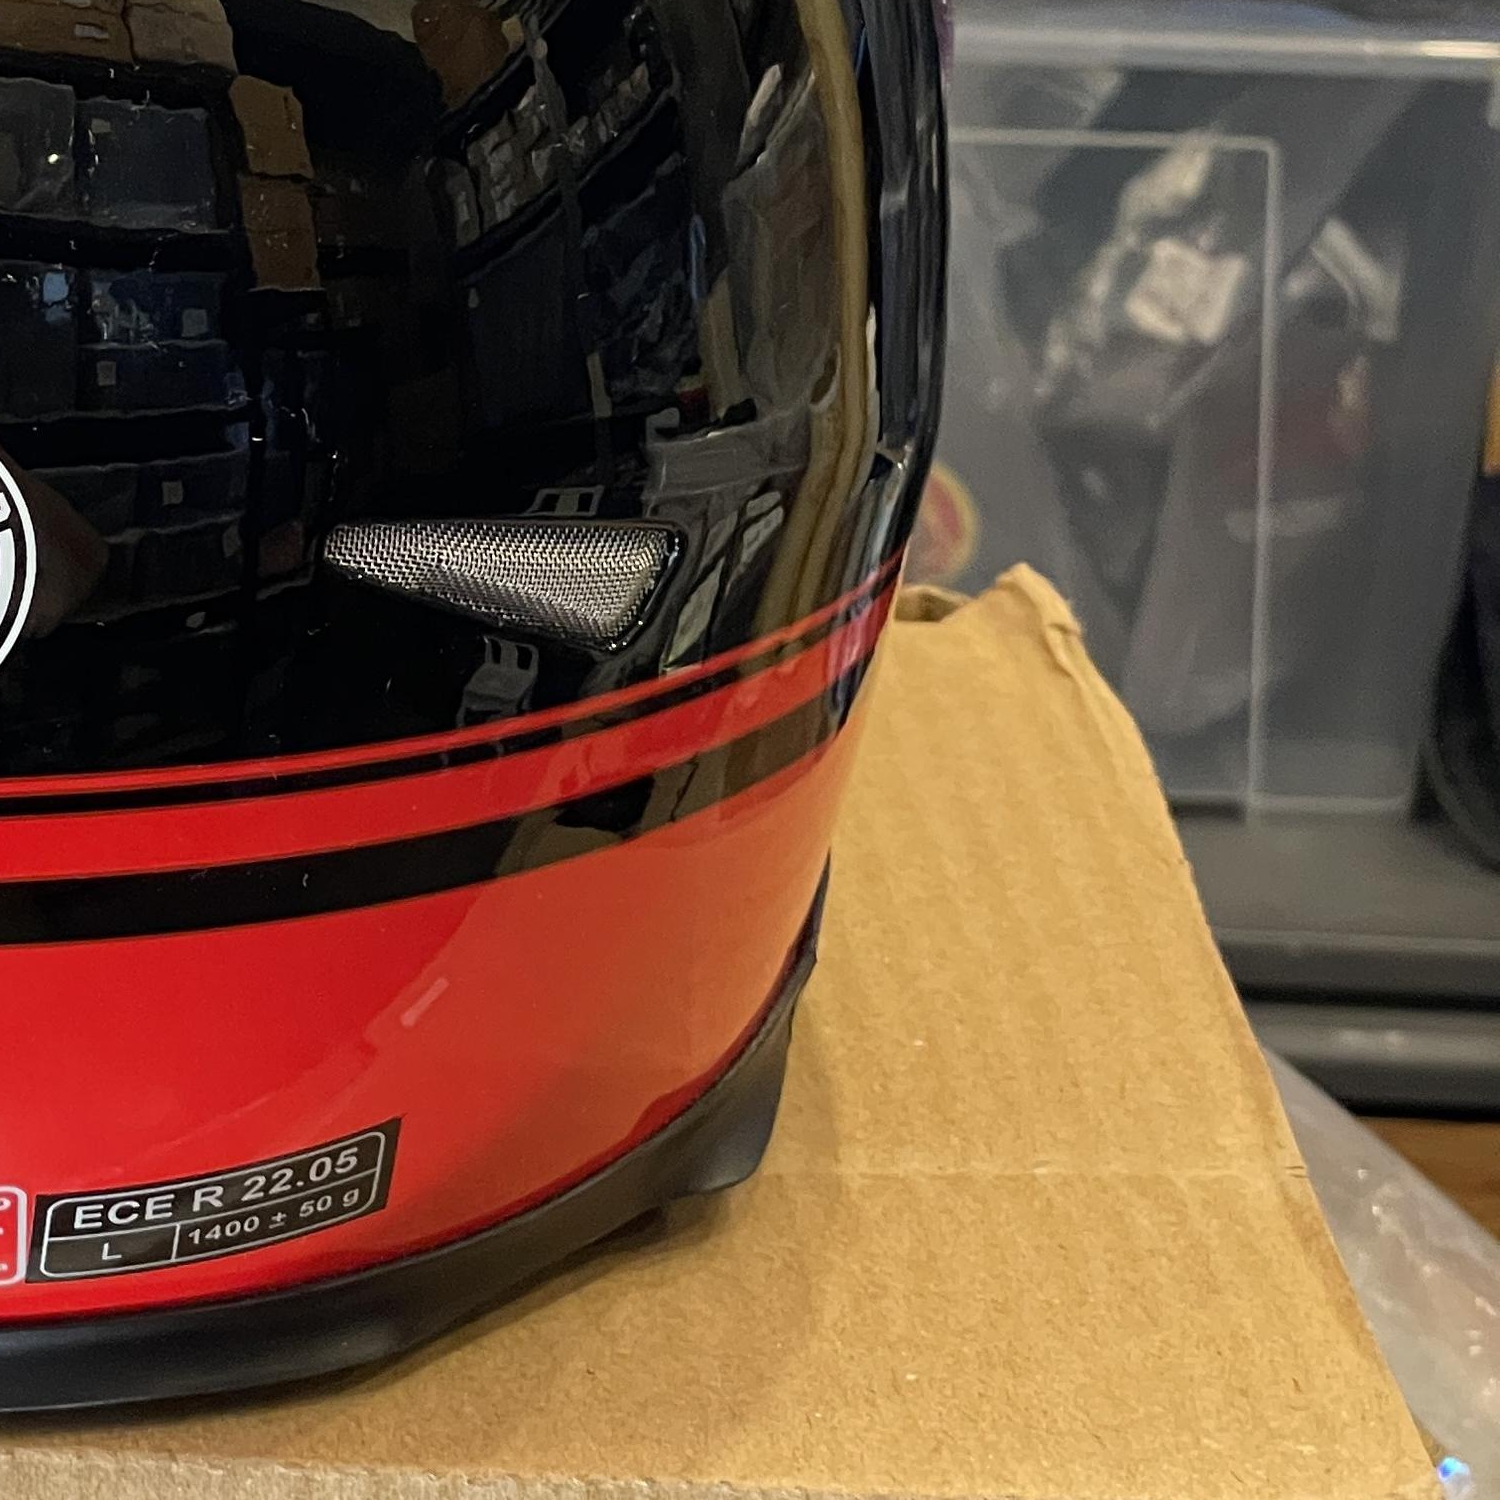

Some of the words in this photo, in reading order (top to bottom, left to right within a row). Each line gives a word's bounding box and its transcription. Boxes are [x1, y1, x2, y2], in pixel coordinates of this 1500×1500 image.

[73, 1193, 176, 1230] ECE
[191, 1184, 225, 1212] R
[241, 1146, 359, 1202] 22.05
[188, 1215, 260, 1245] 1400
[298, 1194, 332, 1219] 50
[342, 1187, 360, 1208] g
[101, 1242, 123, 1261] L
